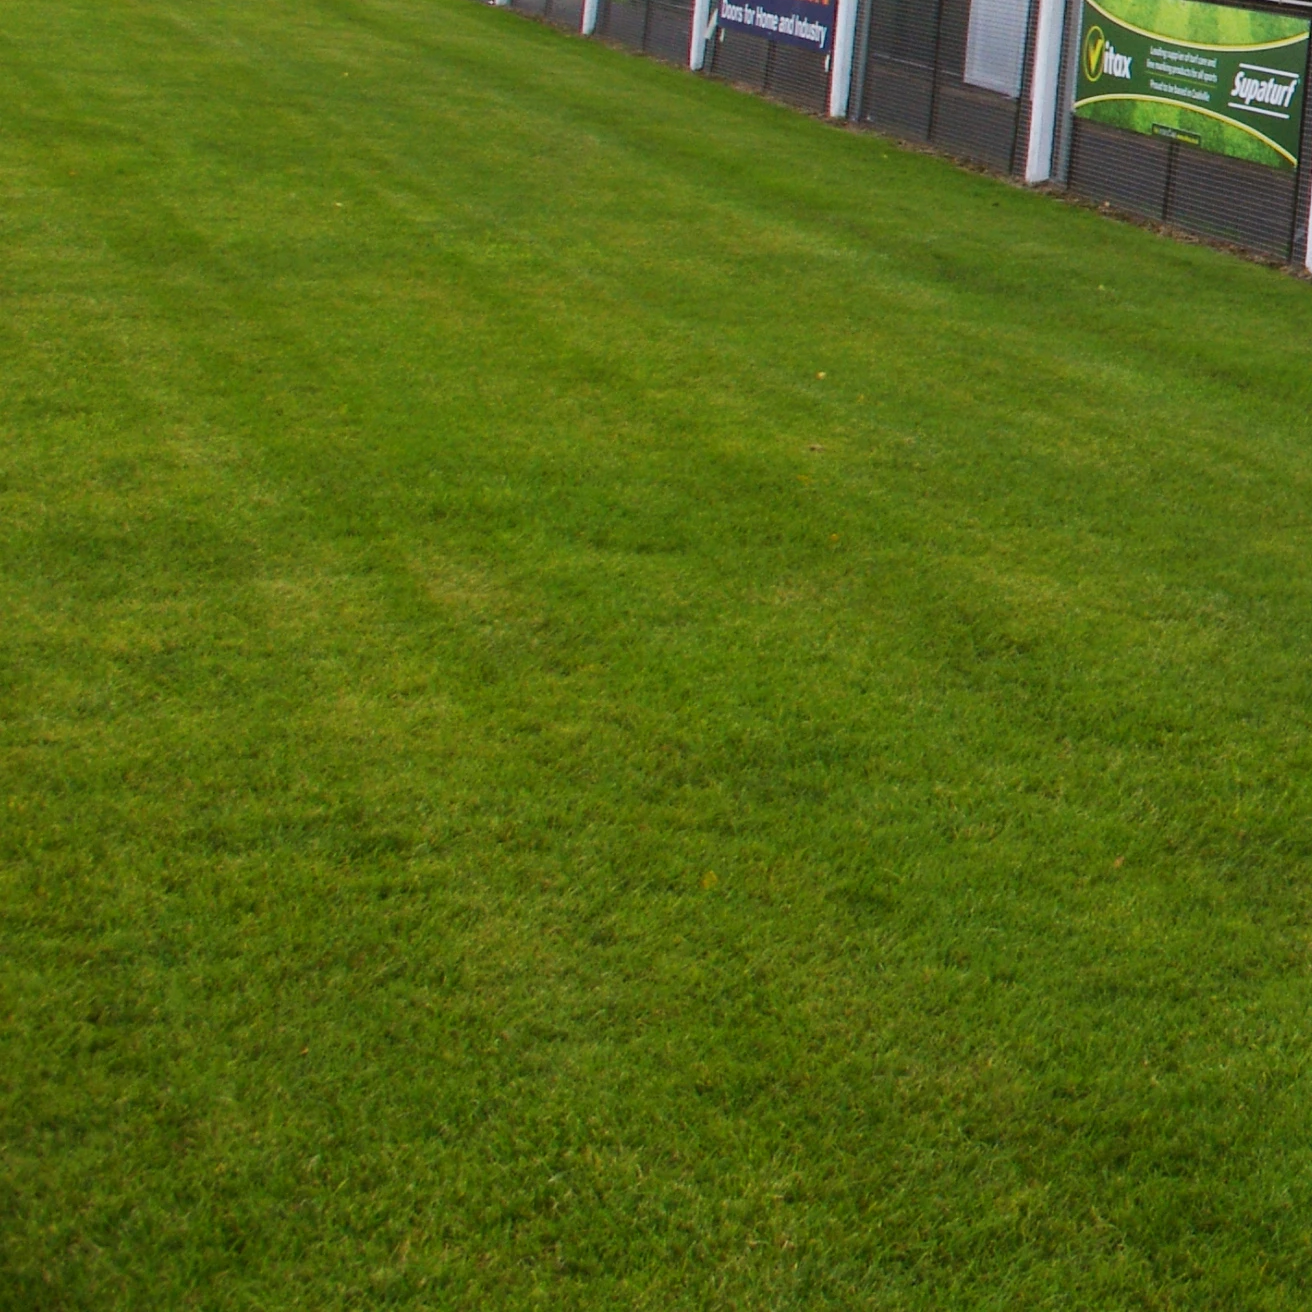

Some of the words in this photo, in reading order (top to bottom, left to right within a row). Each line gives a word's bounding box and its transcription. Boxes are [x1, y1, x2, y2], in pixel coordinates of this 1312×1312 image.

[744, 3, 756, 26] for
[756, 6, 778, 31] Home
[779, 13, 795, 35] and
[795, 14, 828, 49] Industry
[1231, 70, 1299, 108] Supaturf
